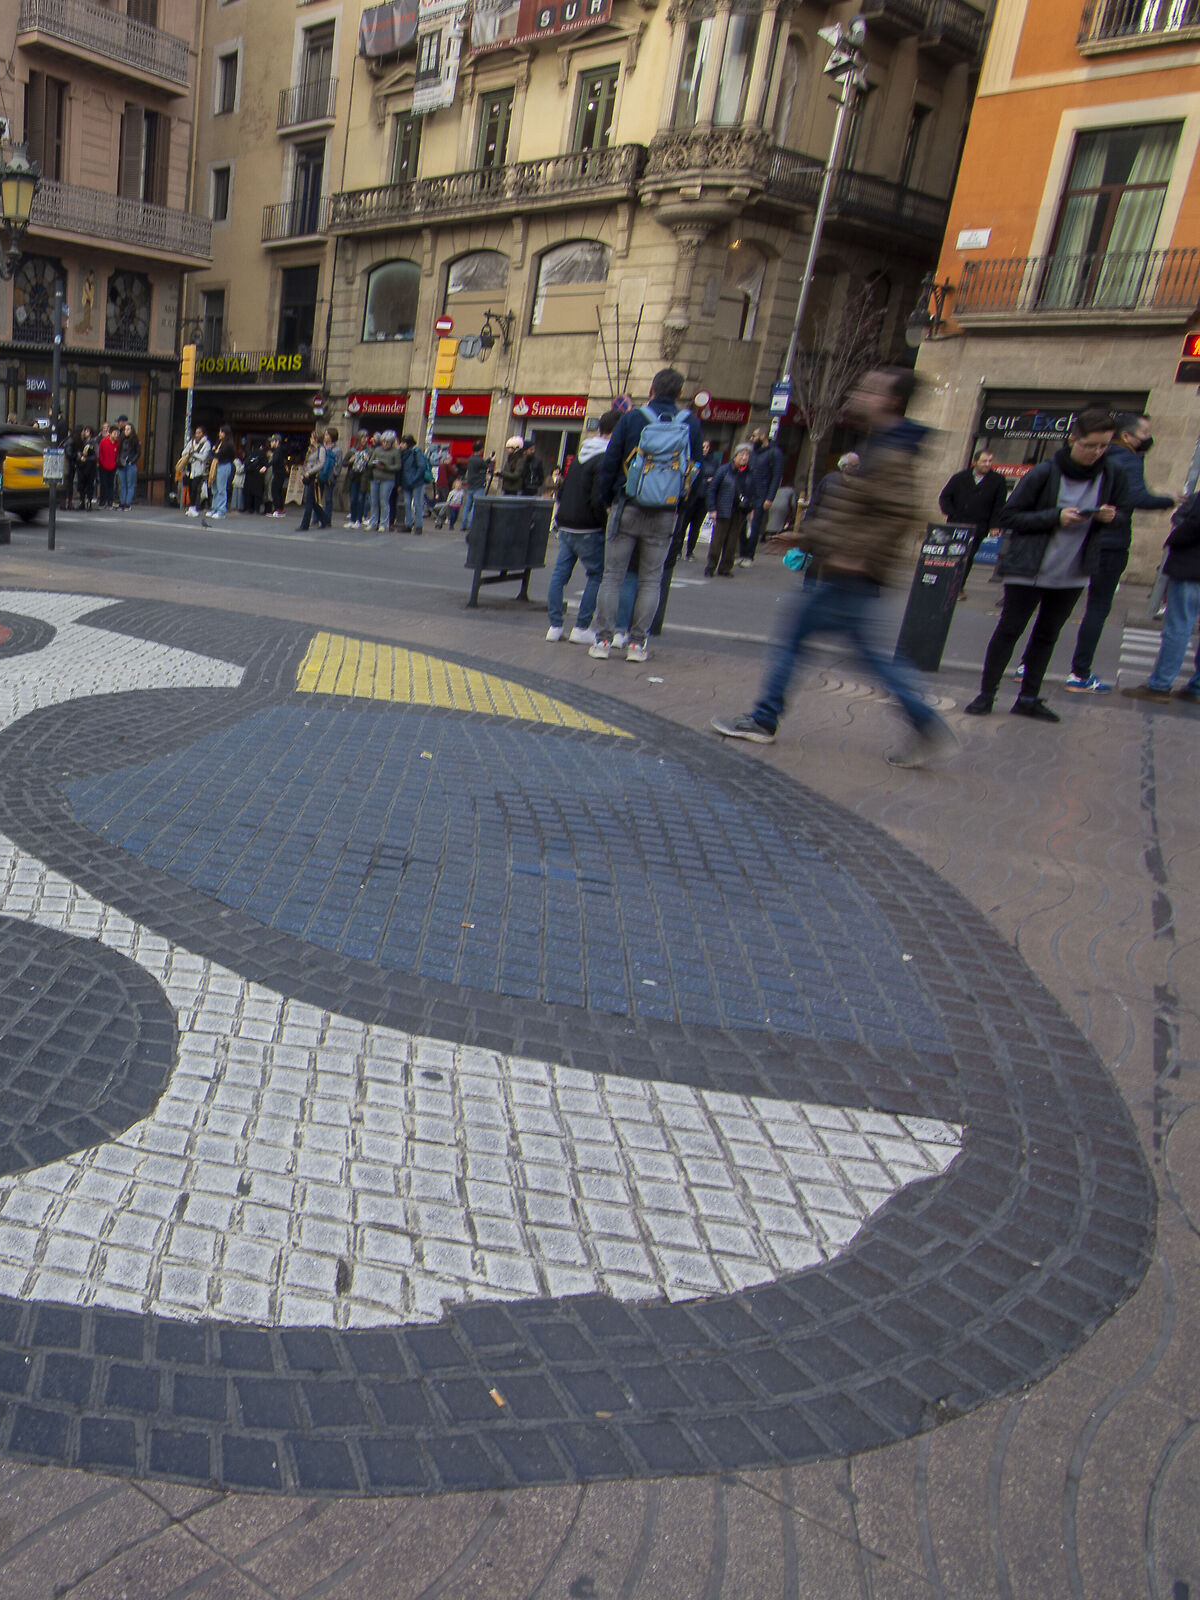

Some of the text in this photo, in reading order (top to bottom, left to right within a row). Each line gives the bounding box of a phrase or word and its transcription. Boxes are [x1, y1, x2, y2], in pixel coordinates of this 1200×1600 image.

[198, 354, 302, 373] HOSTAL PARIS
[111, 380, 130, 390] BBVA
[362, 400, 406, 413] Santander
[531, 401, 587, 416] Santander
[712, 406, 746, 420] Santander
